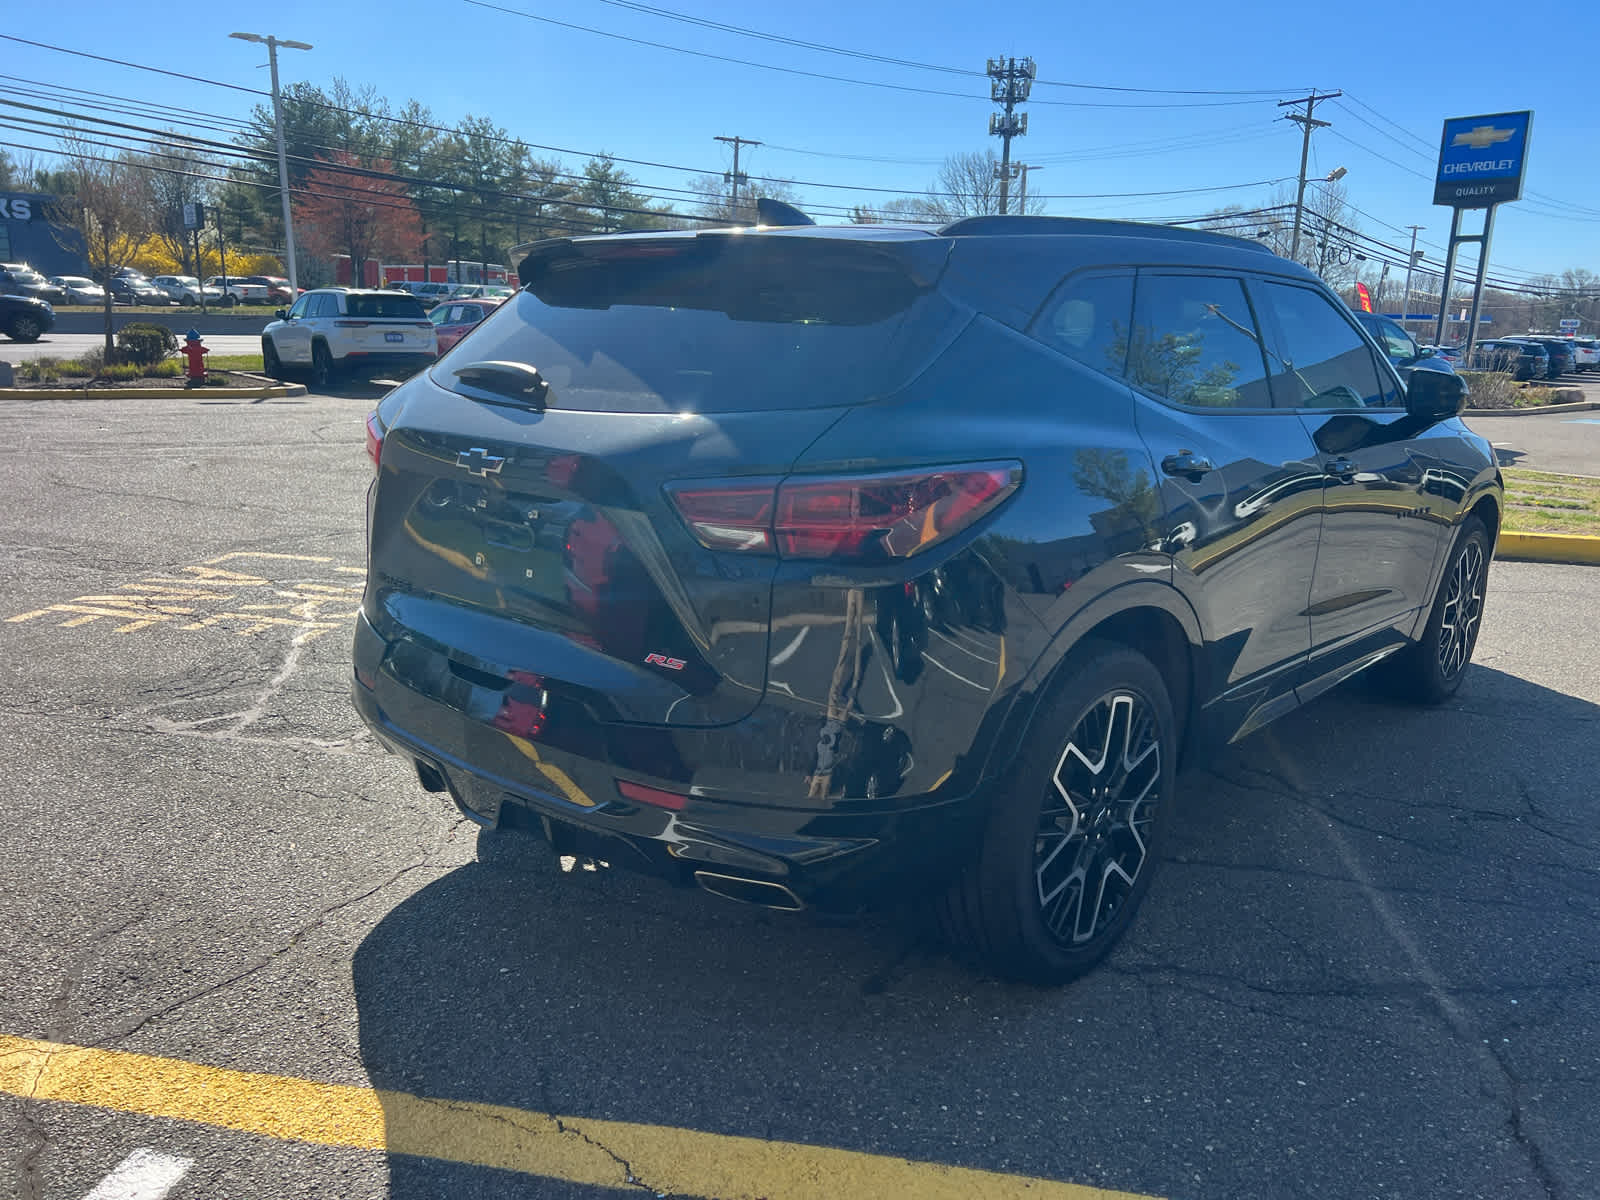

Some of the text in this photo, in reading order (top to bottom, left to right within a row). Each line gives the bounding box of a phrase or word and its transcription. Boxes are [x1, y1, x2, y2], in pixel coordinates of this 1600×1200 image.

[1443, 160, 1515, 174] CHEVROLET
[1455, 186, 1496, 197] QUALITY
[644, 653, 687, 670] RS
